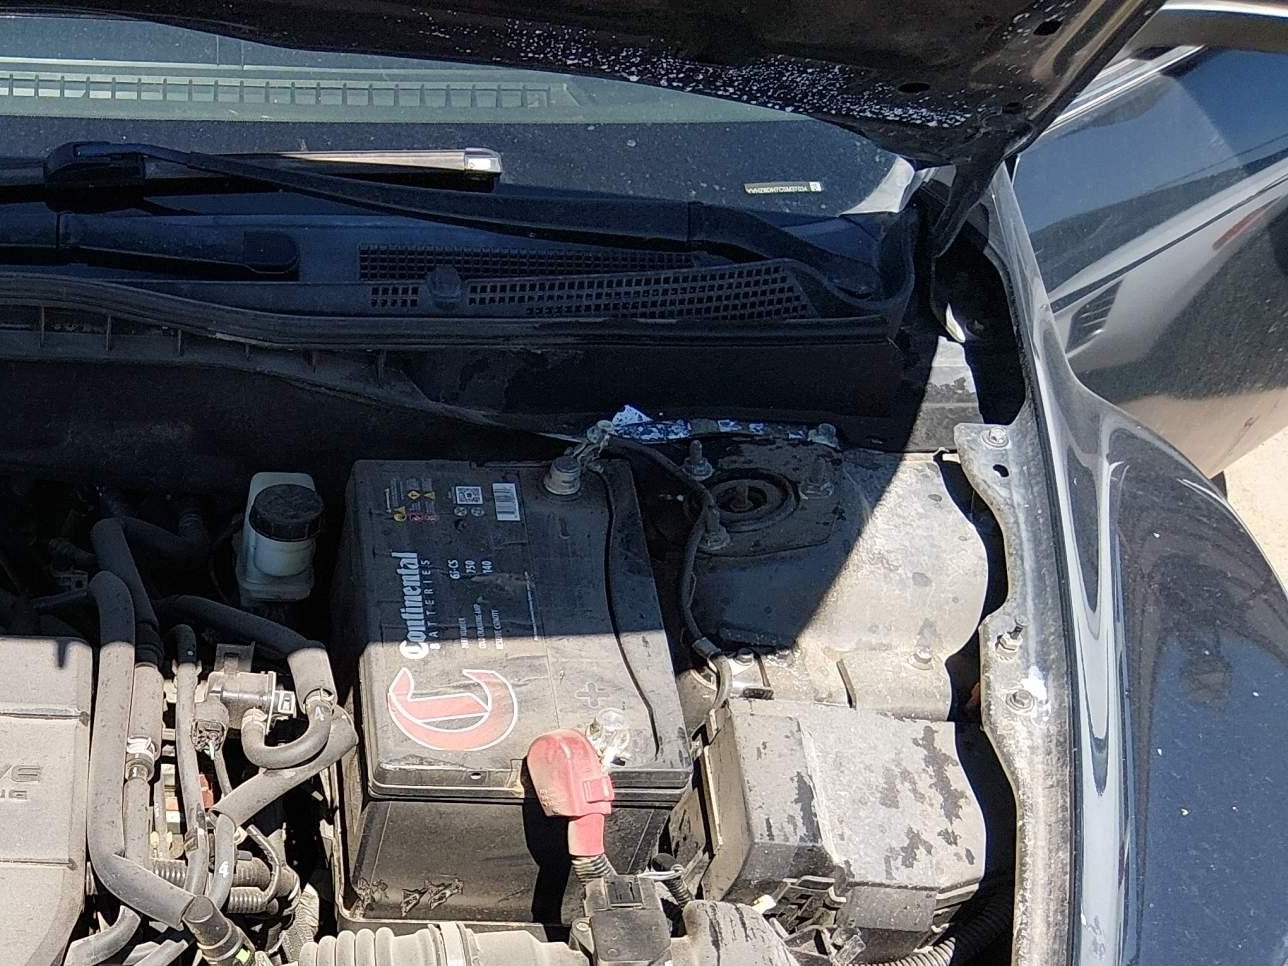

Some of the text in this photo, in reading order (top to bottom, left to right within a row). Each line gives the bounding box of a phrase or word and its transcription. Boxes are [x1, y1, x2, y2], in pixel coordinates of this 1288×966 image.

[464, 559, 477, 575] 750
[481, 560, 494, 575] 140
[391, 551, 430, 659] Continental
[420, 558, 440, 651] BATTERIES
[218, 861, 230, 878] 4
